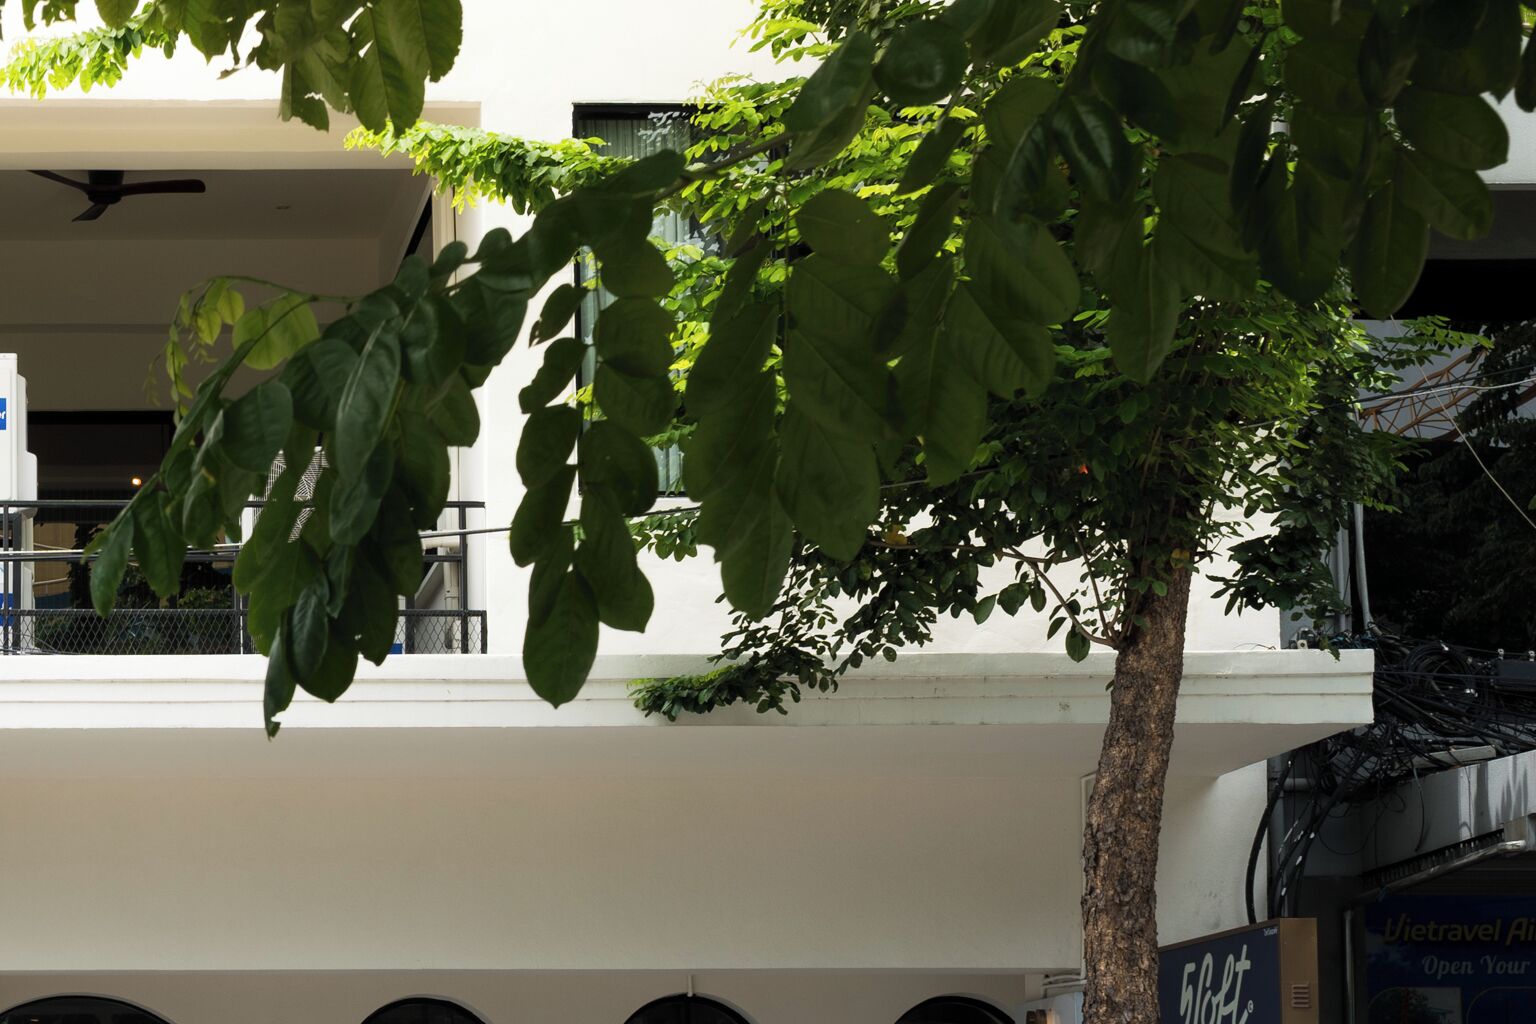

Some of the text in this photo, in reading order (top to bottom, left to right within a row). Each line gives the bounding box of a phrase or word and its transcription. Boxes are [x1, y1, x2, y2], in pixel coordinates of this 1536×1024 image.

[1383, 913, 1502, 943] Vietravel
[1421, 954, 1531, 981] Open Your
